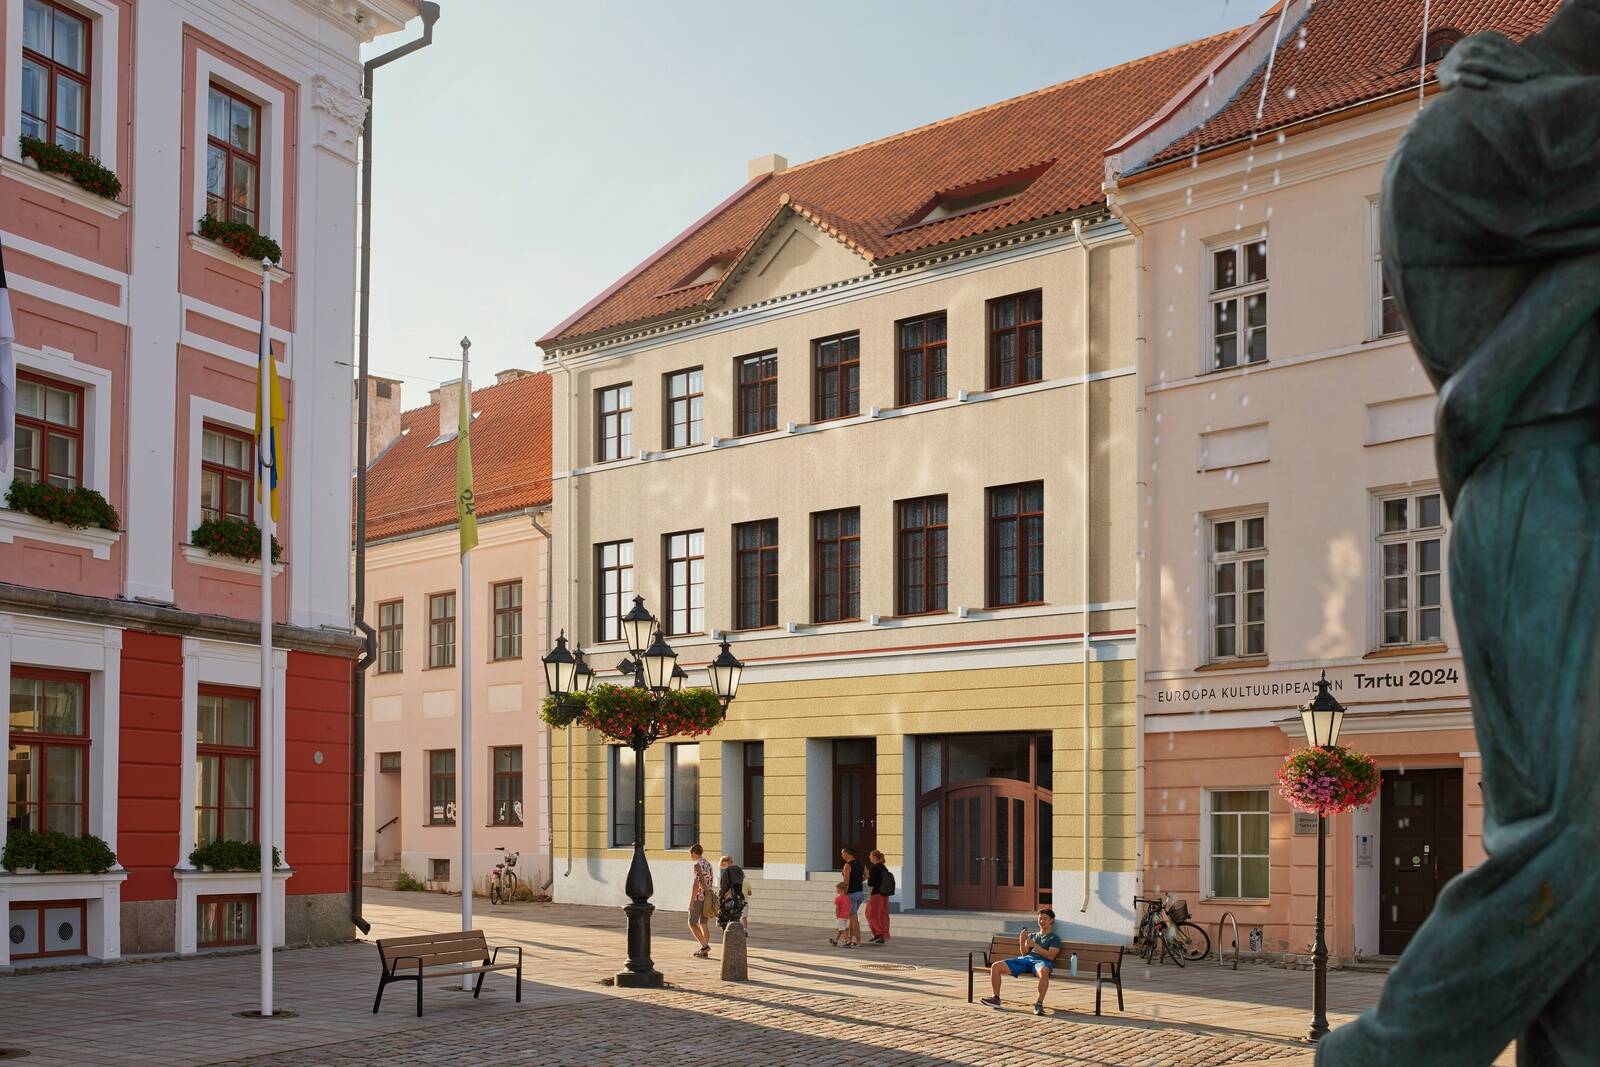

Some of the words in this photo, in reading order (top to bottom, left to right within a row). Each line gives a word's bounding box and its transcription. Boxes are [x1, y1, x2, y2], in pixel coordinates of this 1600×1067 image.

[1158, 688, 1216, 703] EUROOPA
[1221, 679, 1343, 698] KULTUURIPEALNN
[1353, 672, 1404, 690] Tartu
[1408, 668, 1459, 686] 2024
